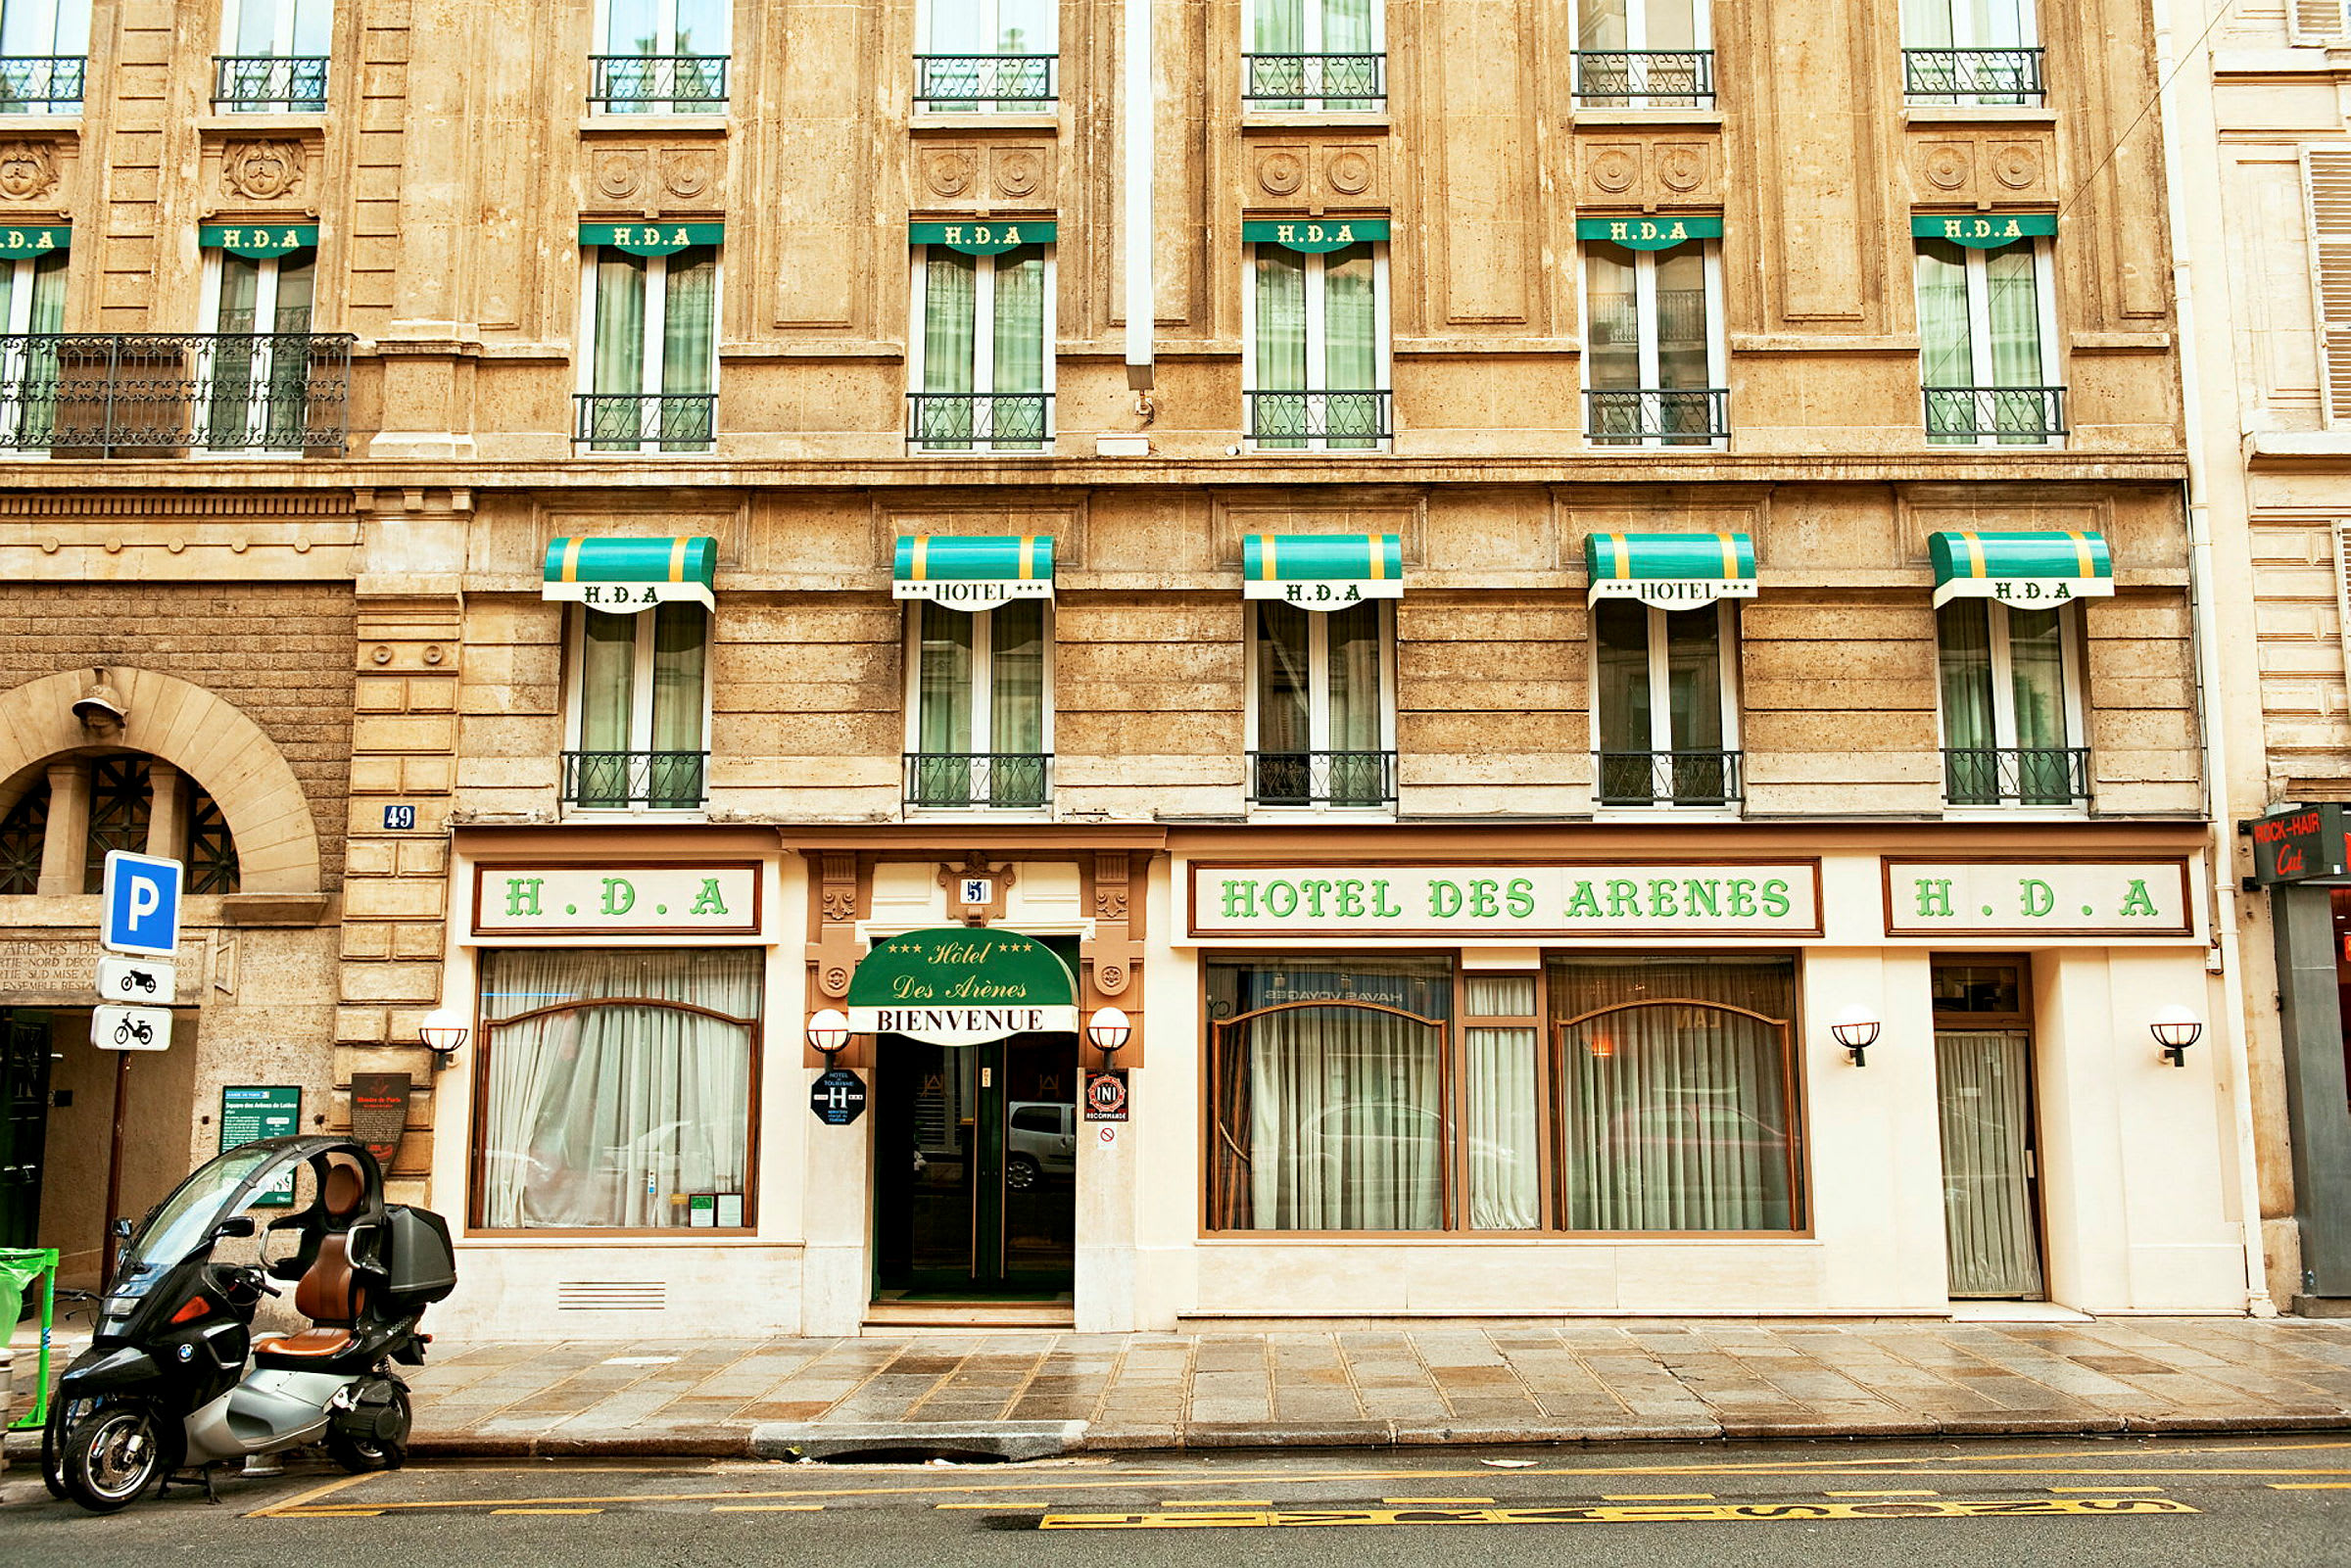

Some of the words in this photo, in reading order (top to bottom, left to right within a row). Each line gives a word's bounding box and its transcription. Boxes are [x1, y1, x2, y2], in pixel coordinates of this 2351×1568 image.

[614, 227, 691, 245] H.D.A
[944, 226, 1022, 245] H.D.A
[1277, 224, 1355, 243] H.D.A
[1610, 221, 1688, 241] H.D.A
[1943, 219, 2023, 238] H.D.A
[223, 230, 300, 248] H.D.A
[585, 586, 658, 603] H.D.A
[936, 584, 1012, 600] HOTEL
[1286, 584, 1362, 601] H.D.A
[1641, 583, 1717, 599] HOTEL
[1994, 582, 2072, 599] H.D.A
[387, 807, 411, 828] 49
[2277, 843, 2305, 876] Cut
[967, 880, 986, 902] 51
[1222, 879, 1402, 918] HOTEL
[1427, 878, 1535, 919] DES
[1564, 879, 1791, 918] ARENES
[128, 876, 160, 931] P
[928, 941, 992, 965] Hôtel
[54, 970, 78, 979] MISE
[892, 974, 934, 999] Des
[945, 974, 1027, 998] Arènes
[877, 1010, 1043, 1031] BIENVENUE
[829, 1087, 847, 1109] H
[1048, 1499, 2183, 1526] LIVRAISONS
